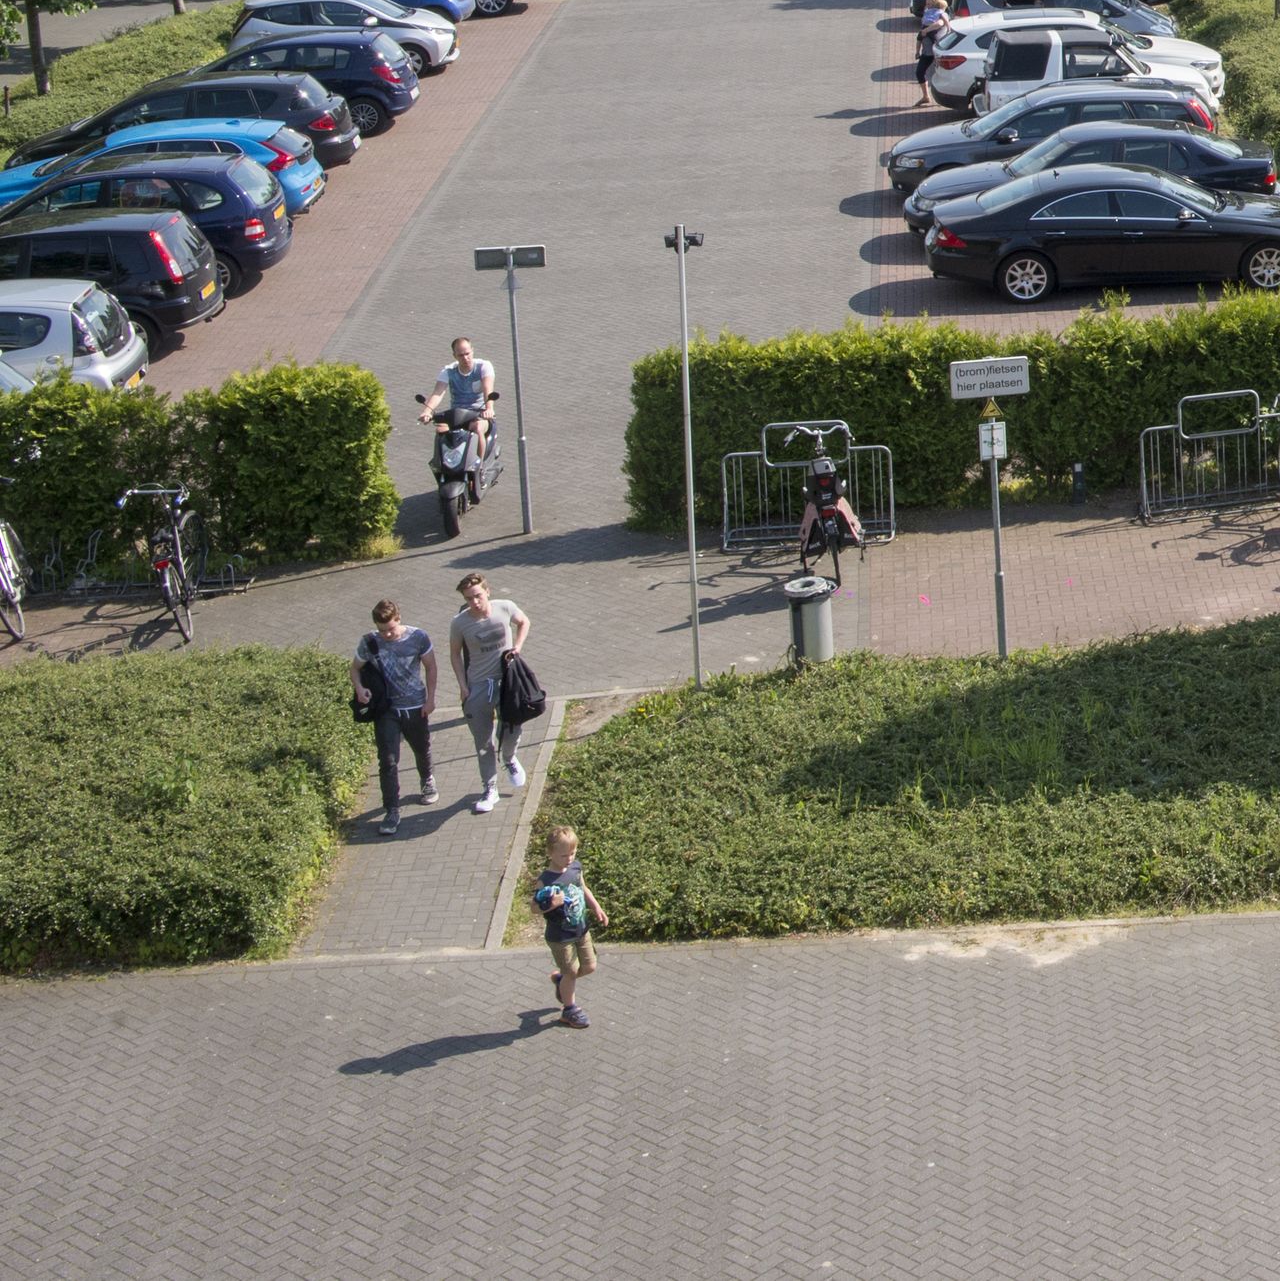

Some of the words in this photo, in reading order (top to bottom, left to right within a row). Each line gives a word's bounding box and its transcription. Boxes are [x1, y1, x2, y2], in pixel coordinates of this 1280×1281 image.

[955, 364, 1023, 379] (brom)fietsen
[957, 382, 976, 392] hier
[980, 379, 1023, 391] plaatsen
